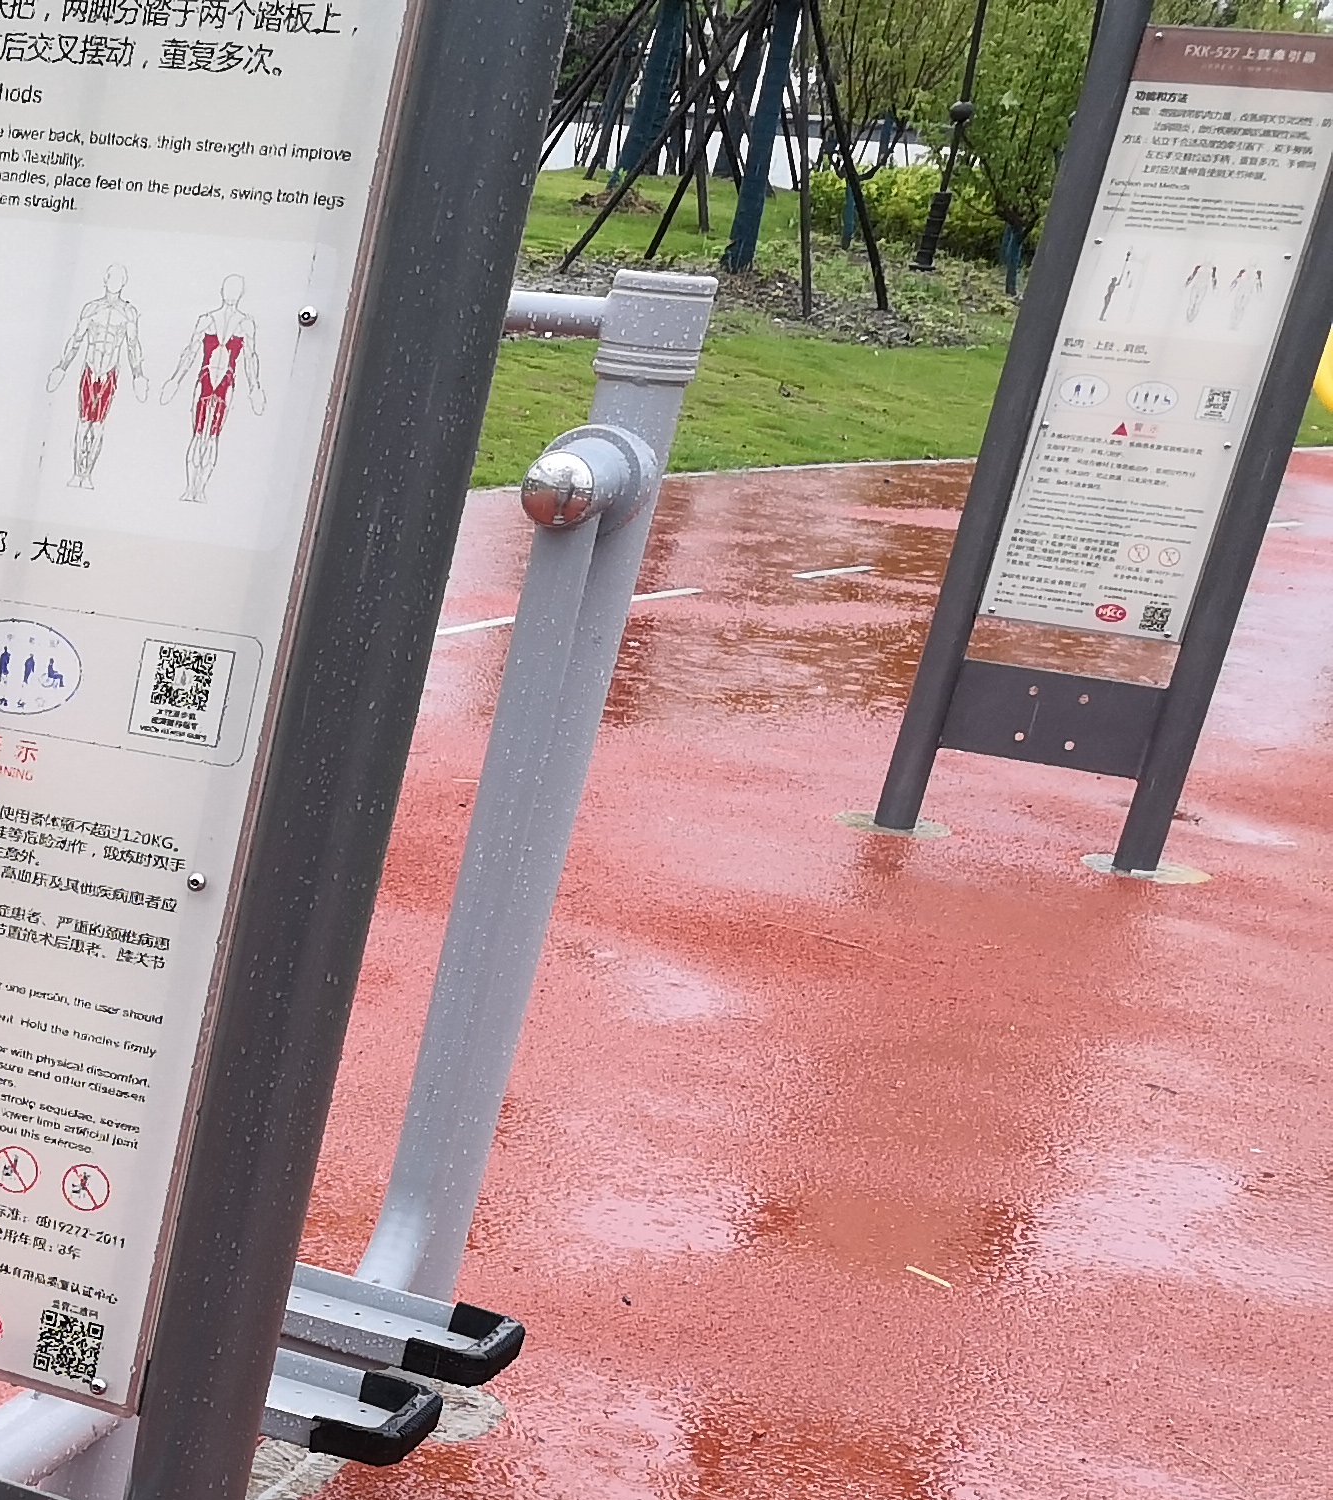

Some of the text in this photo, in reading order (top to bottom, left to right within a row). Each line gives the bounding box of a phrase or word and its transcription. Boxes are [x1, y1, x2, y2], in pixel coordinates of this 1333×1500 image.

[7, 123, 45, 140] lower
[48, 127, 84, 146] back,
[154, 135, 191, 153] thigh
[195, 138, 254, 157] strength
[258, 142, 287, 157] and
[291, 143, 351, 161] improve
[23, 194, 77, 212] straight.
[53, 172, 91, 189] place
[95, 174, 123, 190] feet
[125, 180, 143, 192] on
[147, 179, 169, 194] the
[173, 182, 224, 199] pedals,
[229, 187, 272, 205] swing
[276, 188, 308, 204] both
[313, 191, 345, 210] legs
[28, 988, 69, 1005] person,
[73, 997, 91, 1009] the
[122, 1009, 163, 1024] should
[20, 1017, 47, 1032] Hold
[50, 1024, 69, 1036] the
[123, 1040, 156, 1058] firmly
[10, 1048, 33, 1060] with
[35, 1054, 83, 1072] physical
[27, 1068, 50, 1079] and
[0, 1124, 17, 1135] out
[20, 1127, 40, 1140] this
[36, 1115, 60, 1131] limb
